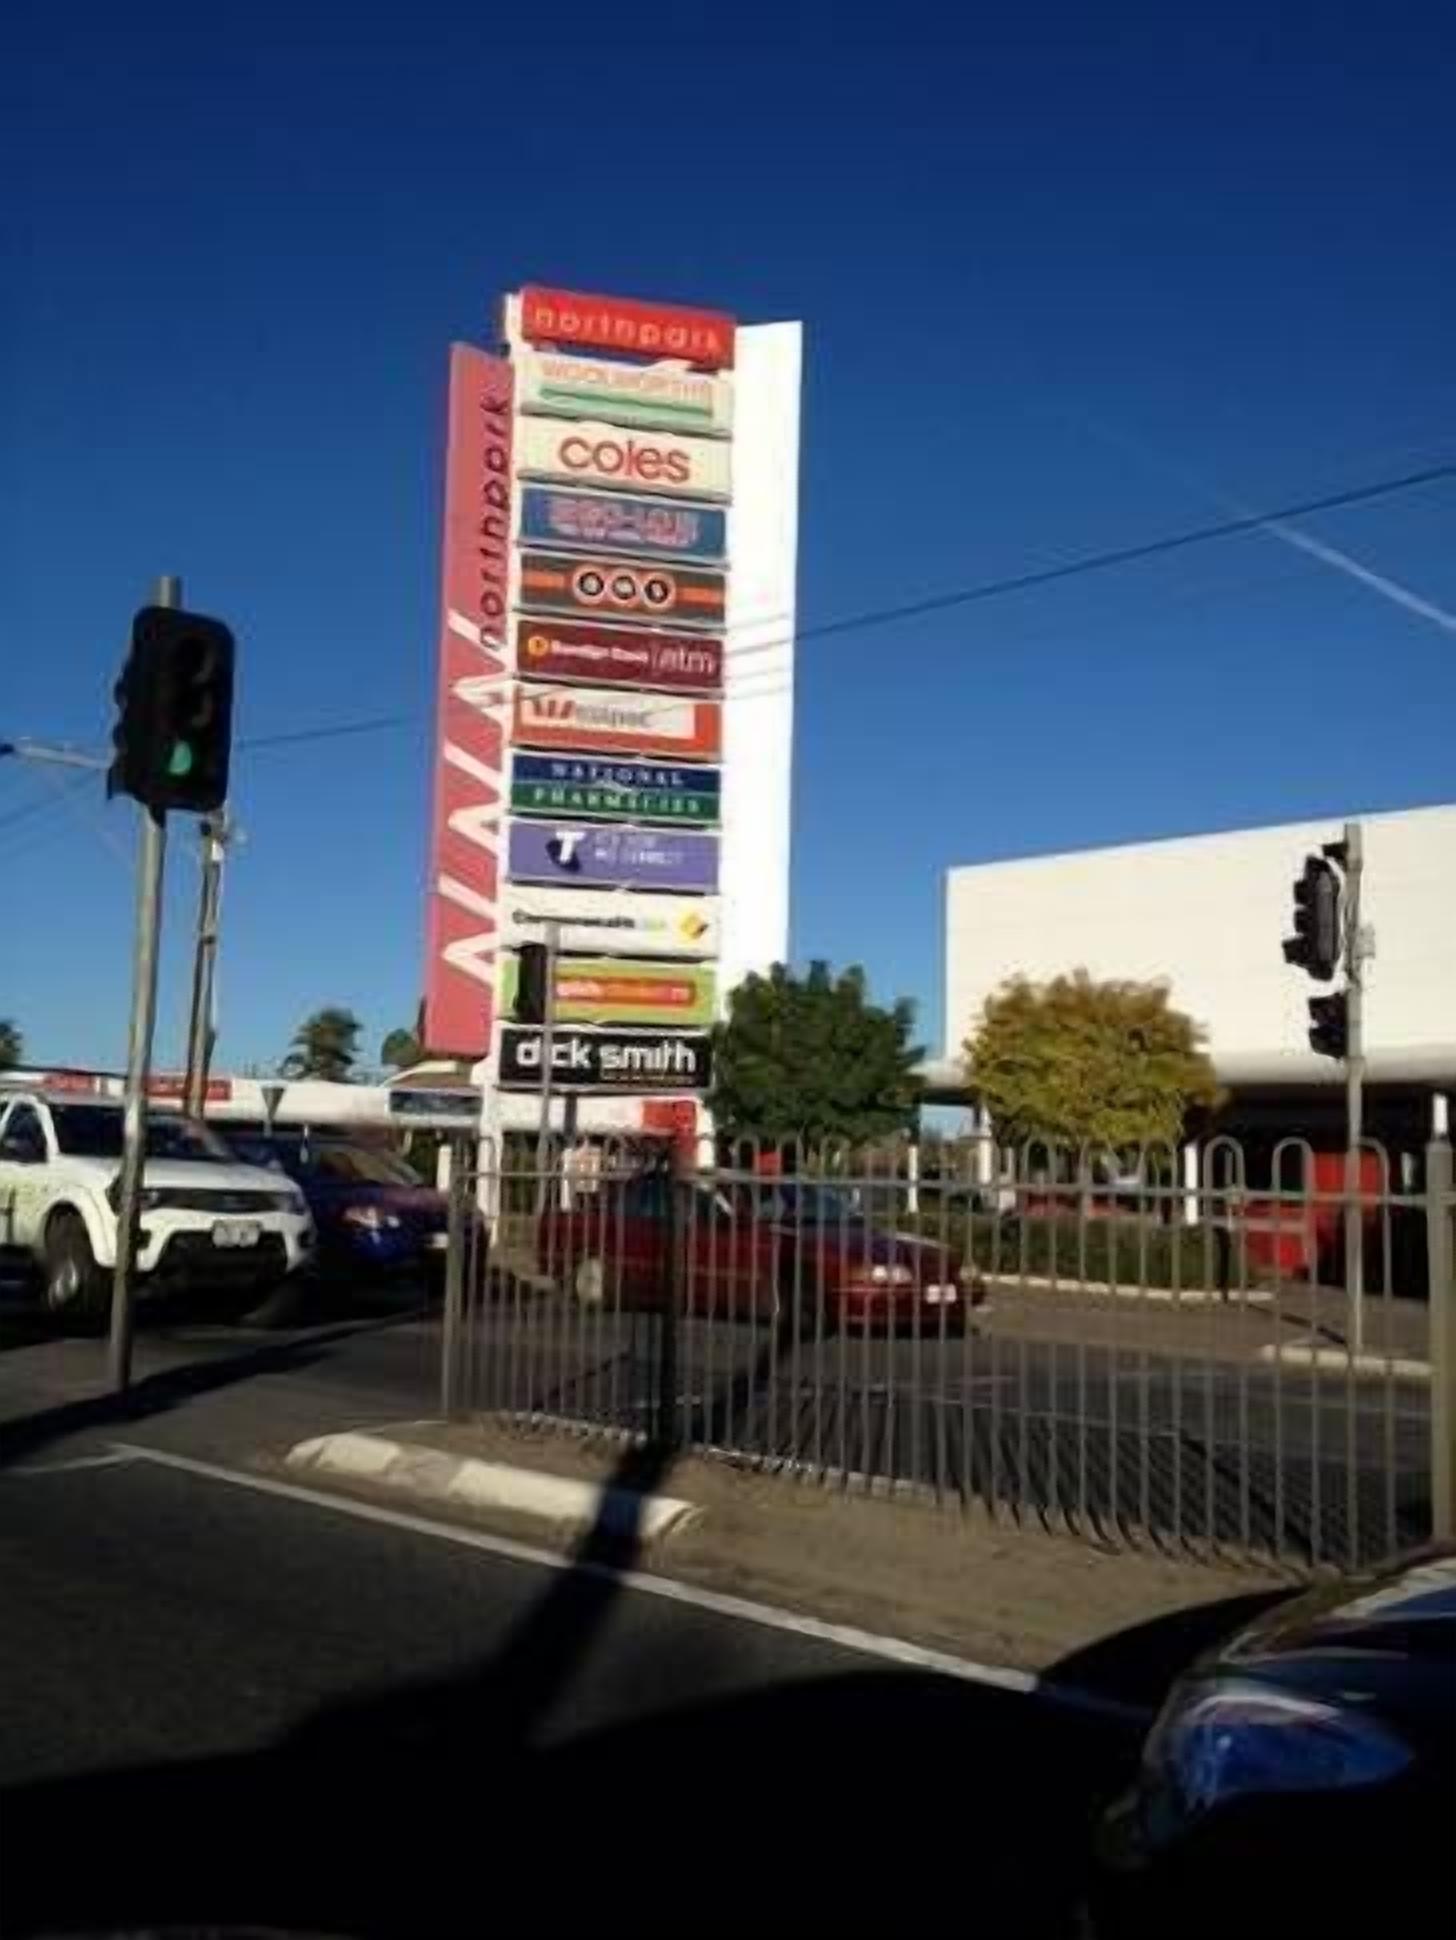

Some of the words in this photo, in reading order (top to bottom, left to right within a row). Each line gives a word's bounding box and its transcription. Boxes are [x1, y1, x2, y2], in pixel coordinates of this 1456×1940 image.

[558, 436, 690, 482] coles
[552, 761, 684, 786] NATIONAL
[516, 1036, 592, 1069] dck
[601, 1039, 697, 1072] smith
